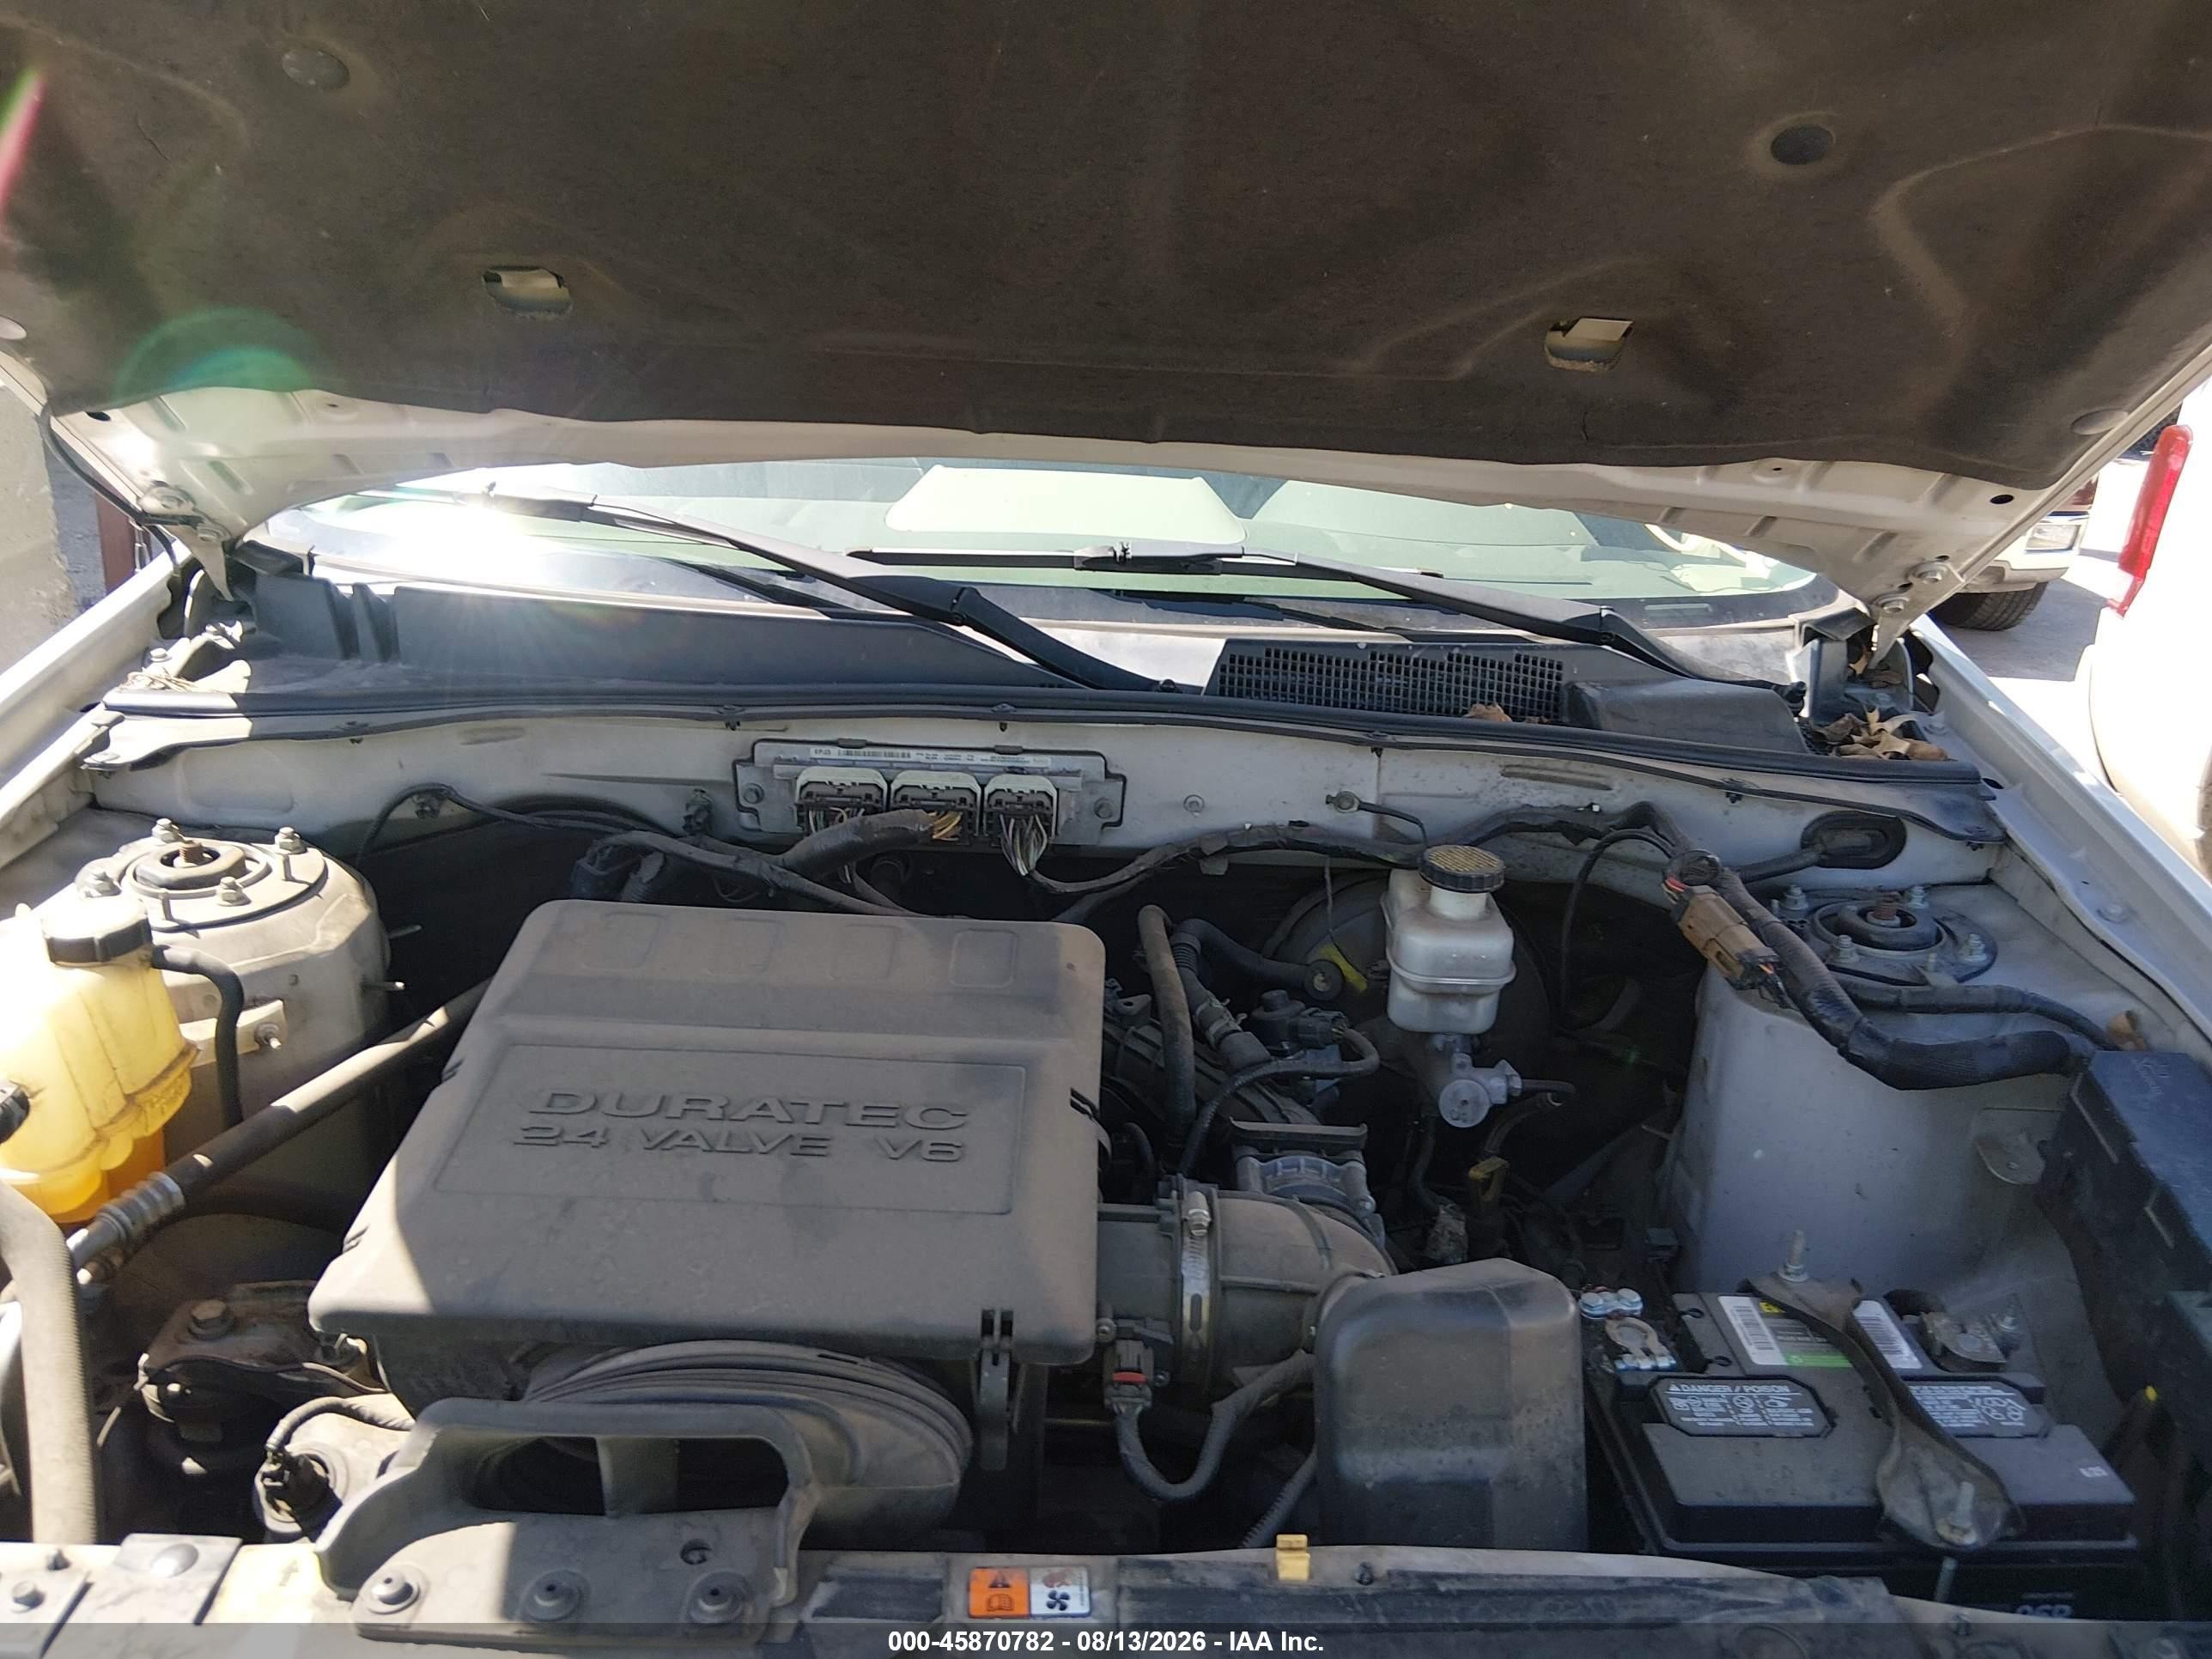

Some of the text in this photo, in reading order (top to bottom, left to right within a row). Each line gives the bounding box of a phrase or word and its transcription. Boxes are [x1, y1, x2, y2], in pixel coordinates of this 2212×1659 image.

[529, 1091, 969, 1130] DURATEC
[514, 1126, 964, 1162] 24 VALVE V6
[1680, 1385, 1733, 1394] DANGER
[1743, 1385, 1792, 1394] POISON
